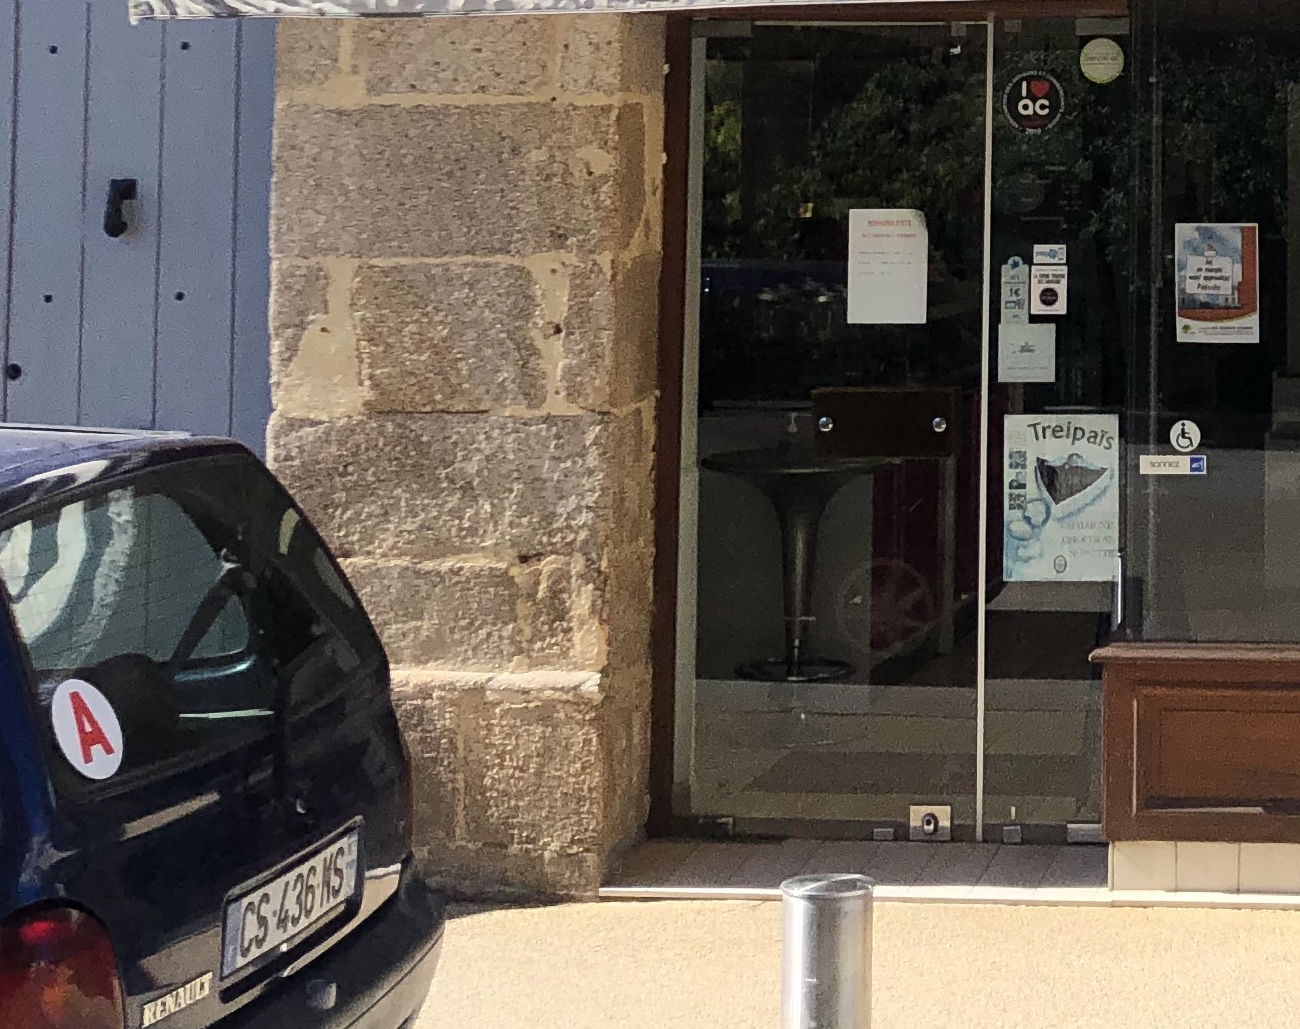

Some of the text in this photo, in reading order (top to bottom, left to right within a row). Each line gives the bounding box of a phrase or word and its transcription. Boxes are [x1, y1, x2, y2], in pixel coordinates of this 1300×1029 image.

[1017, 98, 1050, 116] ac
[1027, 421, 1115, 450] Treipaïs
[1149, 460, 1180, 468] sonnez
[68, 690, 115, 764] A
[142, 972, 213, 1028] RENAULT
